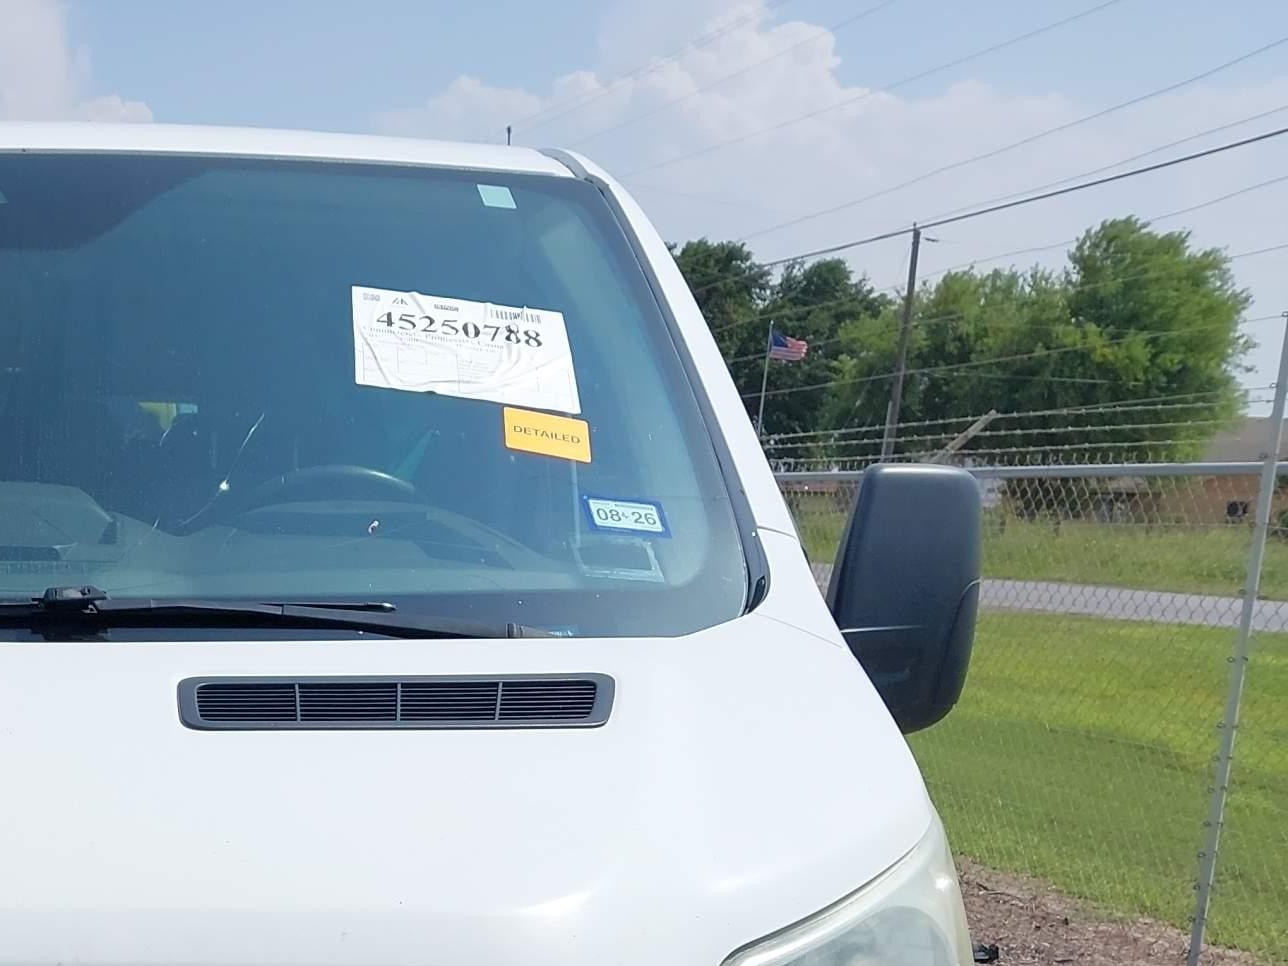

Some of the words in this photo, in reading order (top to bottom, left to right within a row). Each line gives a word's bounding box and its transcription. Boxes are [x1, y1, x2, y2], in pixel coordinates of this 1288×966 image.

[376, 311, 543, 348] 45250788
[513, 425, 581, 444] DETAILED
[596, 508, 622, 522] 08
[631, 511, 657, 526] 26
